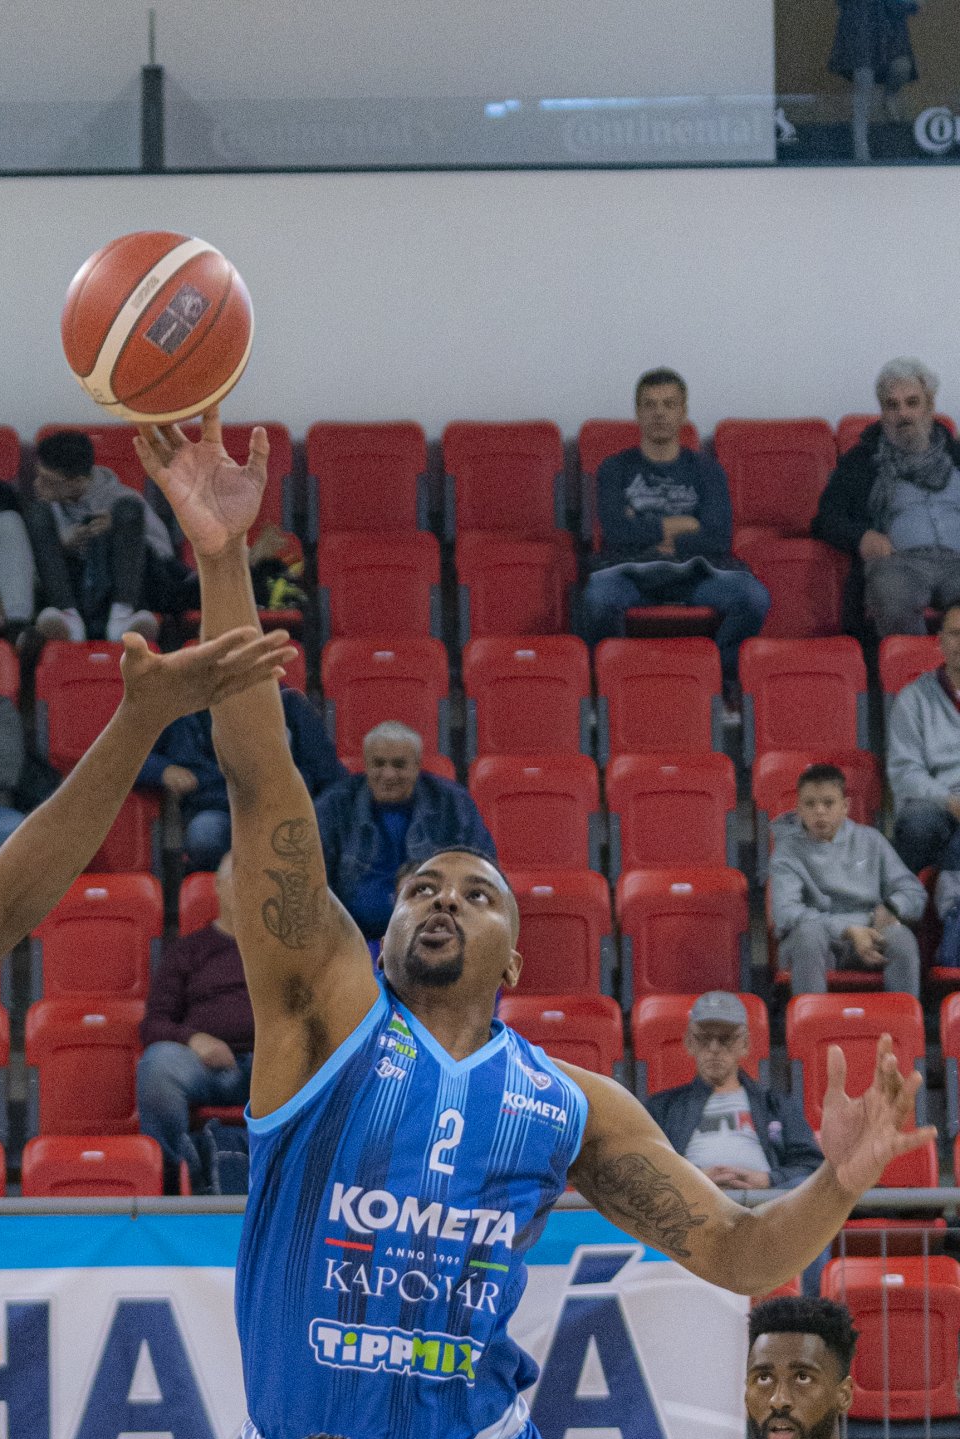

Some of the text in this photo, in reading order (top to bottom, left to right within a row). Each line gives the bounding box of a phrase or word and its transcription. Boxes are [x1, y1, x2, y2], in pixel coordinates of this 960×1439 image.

[503, 1091, 567, 1124] KOMETA
[428, 1108, 465, 1176] 2
[328, 1182, 515, 1249] KOMETA
[385, 1246, 461, 1265] ANNO 1999
